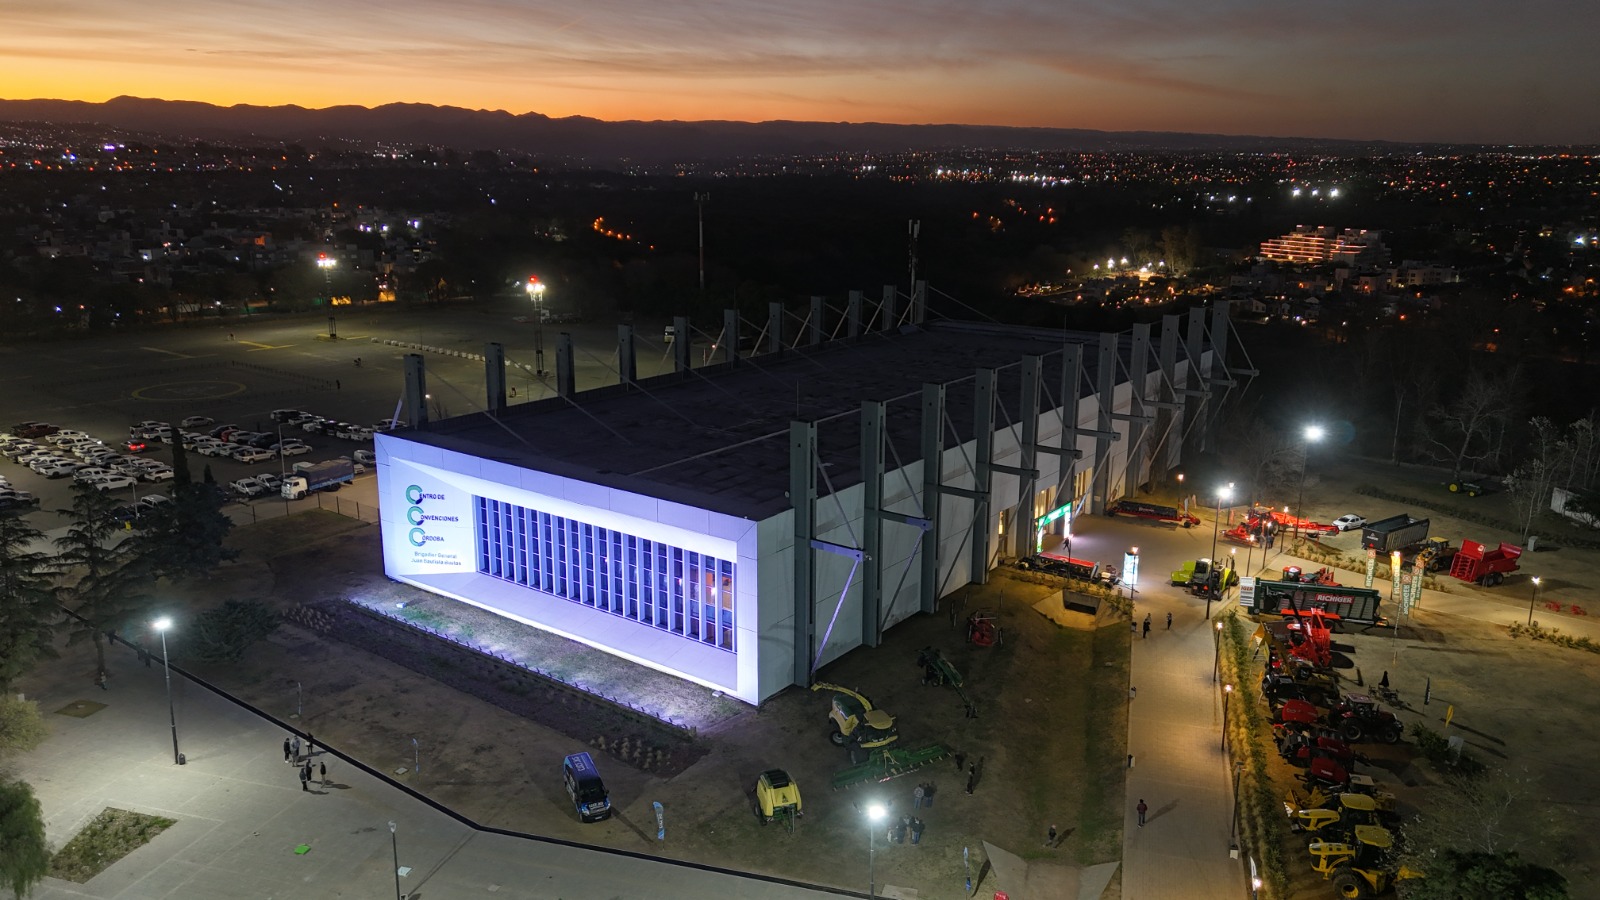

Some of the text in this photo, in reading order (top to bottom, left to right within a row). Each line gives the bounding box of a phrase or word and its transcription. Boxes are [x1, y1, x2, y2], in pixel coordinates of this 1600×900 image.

[406, 484, 436, 504] CENTRO
[407, 506, 458, 526] CONVENCIONES
[1317, 594, 1352, 603] RICHIGER
